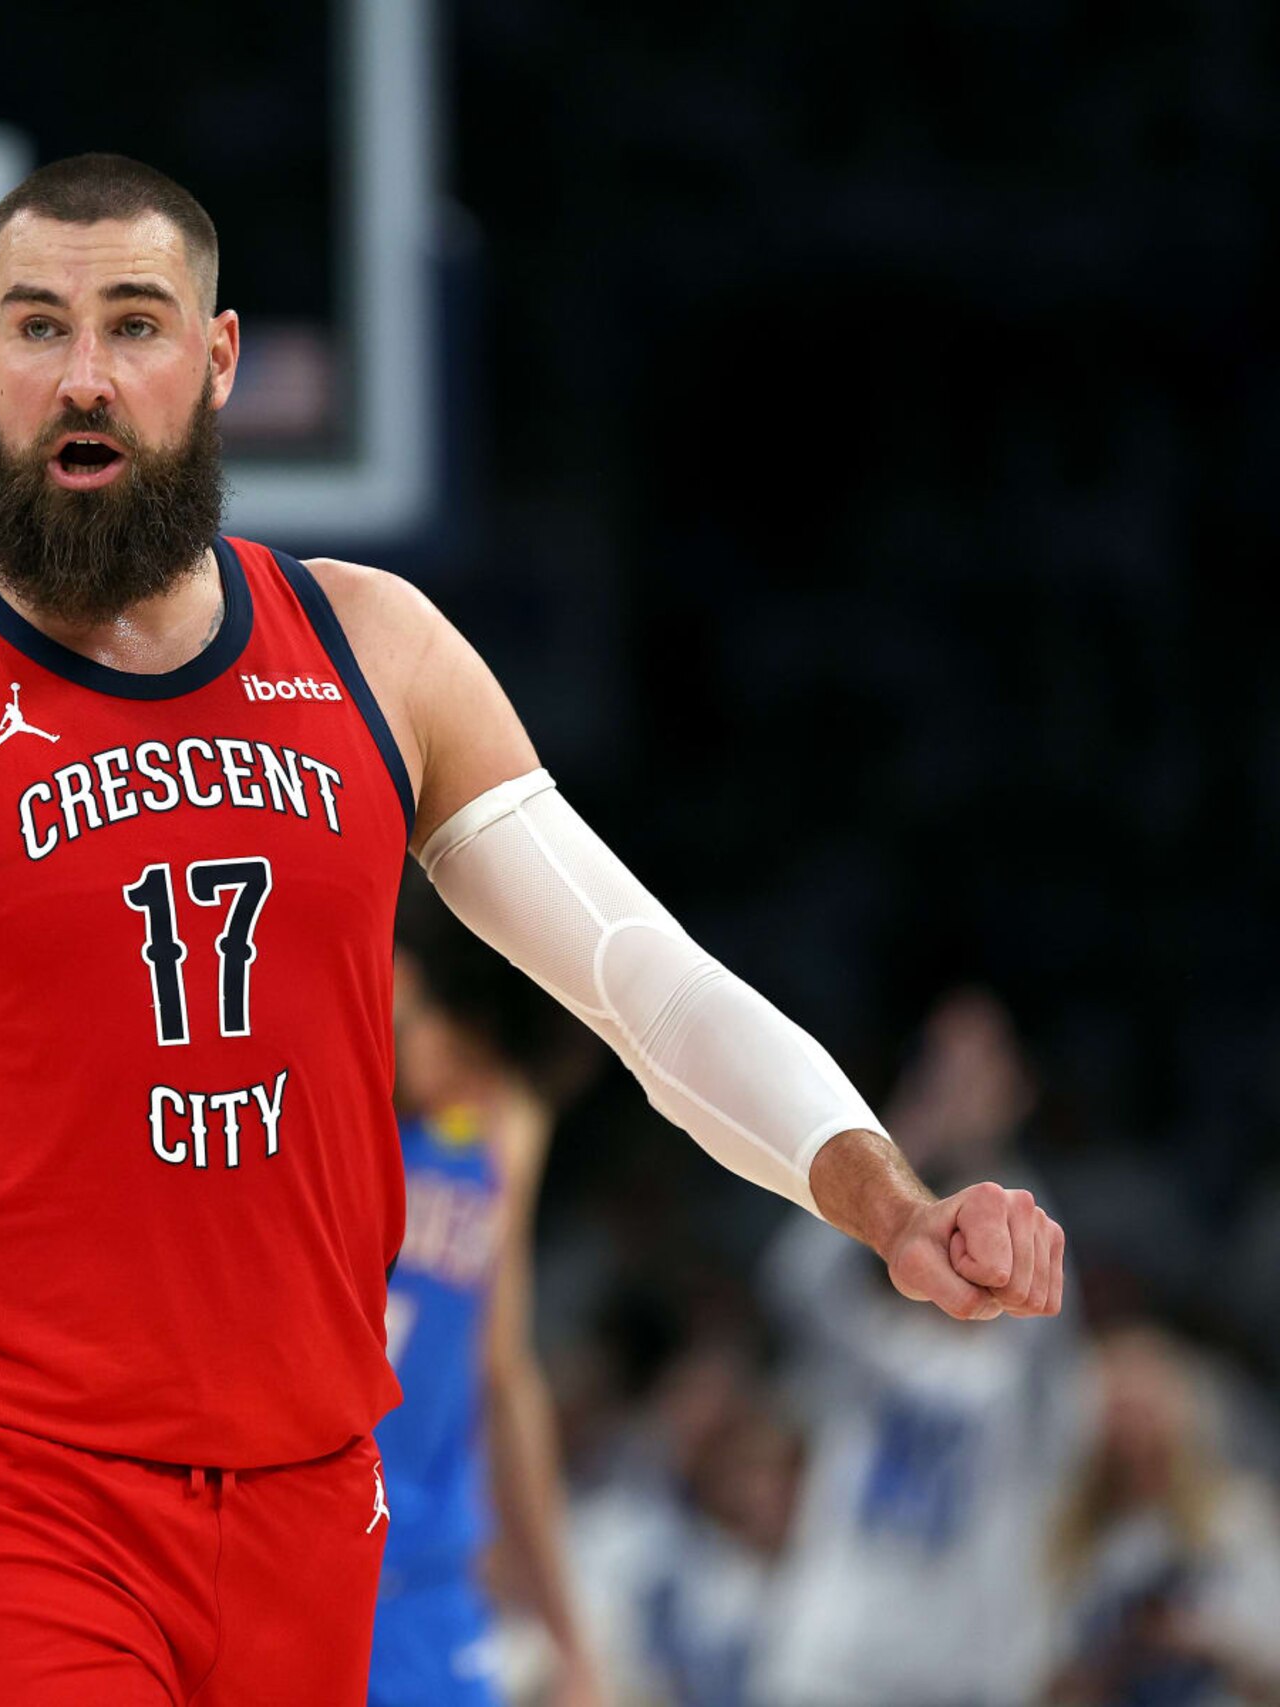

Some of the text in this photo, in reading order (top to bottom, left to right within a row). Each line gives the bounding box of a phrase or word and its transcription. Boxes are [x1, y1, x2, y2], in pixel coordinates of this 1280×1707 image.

[241, 673, 343, 703] ibotta
[18, 737, 344, 860] CRESCENT
[122, 855, 273, 1047] 17
[148, 1067, 289, 1170] CITY
